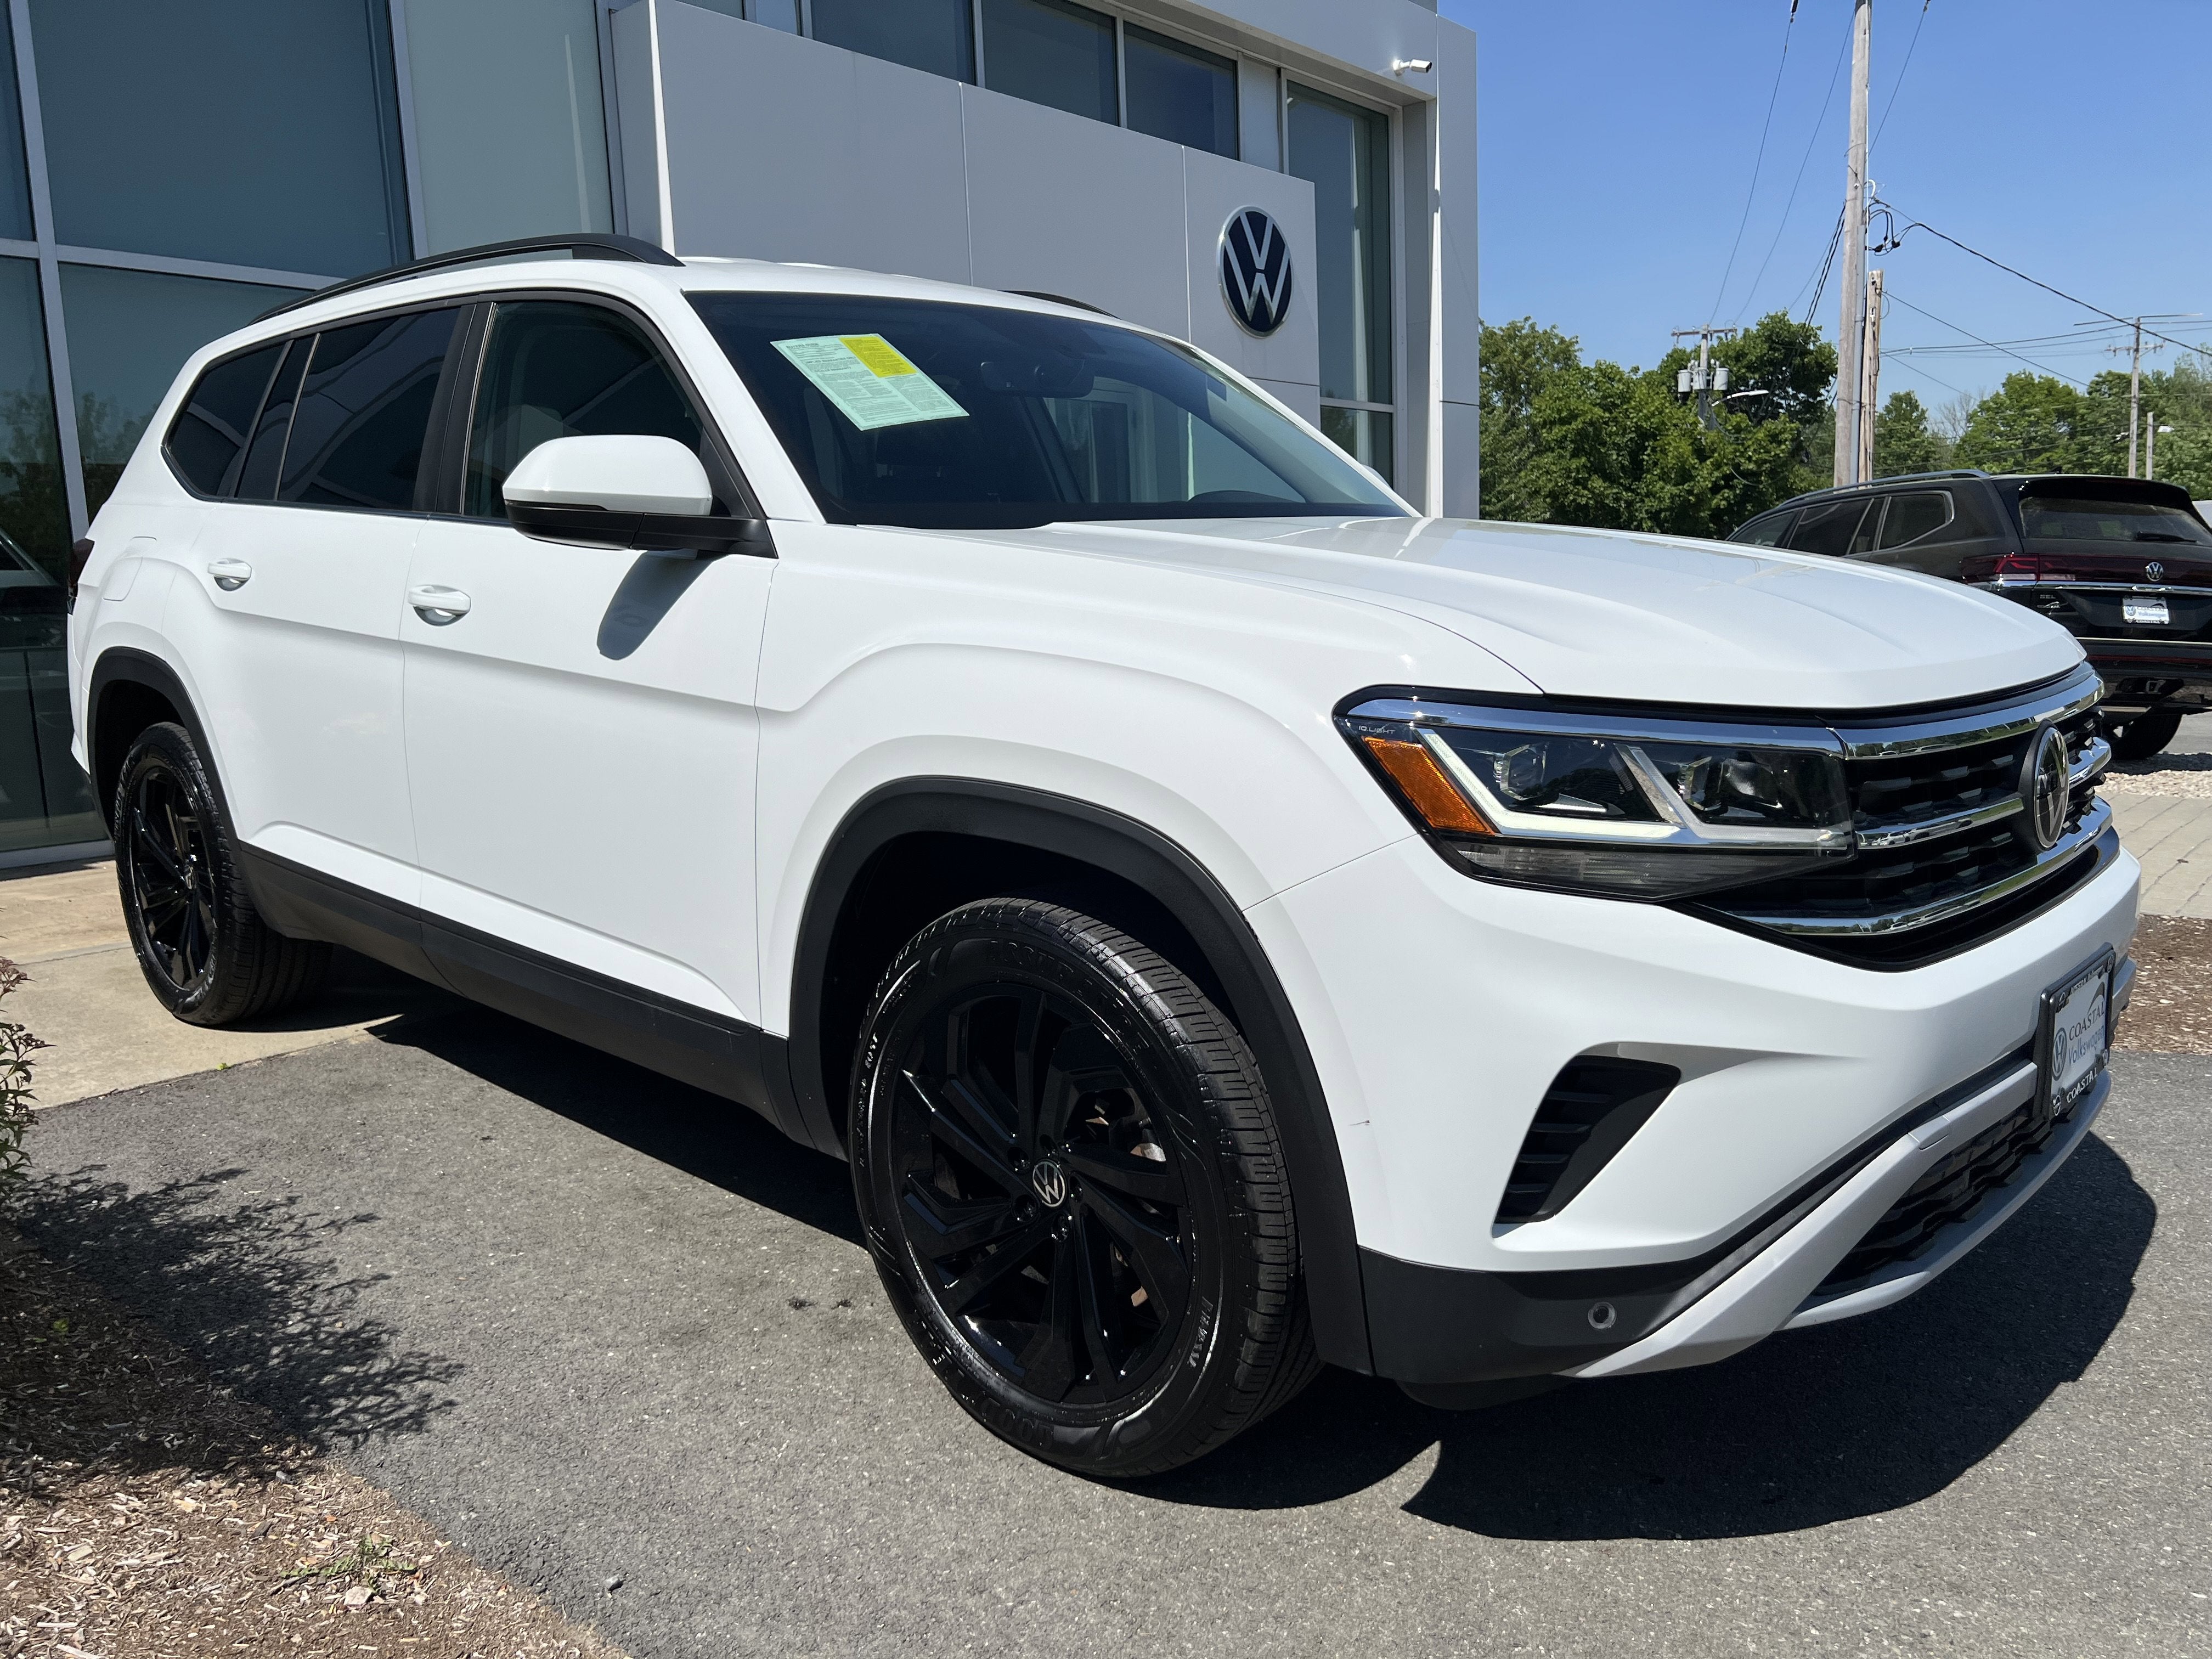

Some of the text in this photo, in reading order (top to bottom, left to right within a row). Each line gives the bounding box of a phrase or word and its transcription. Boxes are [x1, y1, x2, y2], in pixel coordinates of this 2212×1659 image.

[1216, 205, 1294, 338] VW
[1358, 725, 1396, 735] IQ.LIGHT
[2069, 1001, 2105, 1041] COASTAL
[2066, 1067, 2098, 1103] COASTAL
[1032, 1161, 1065, 1207] VW
